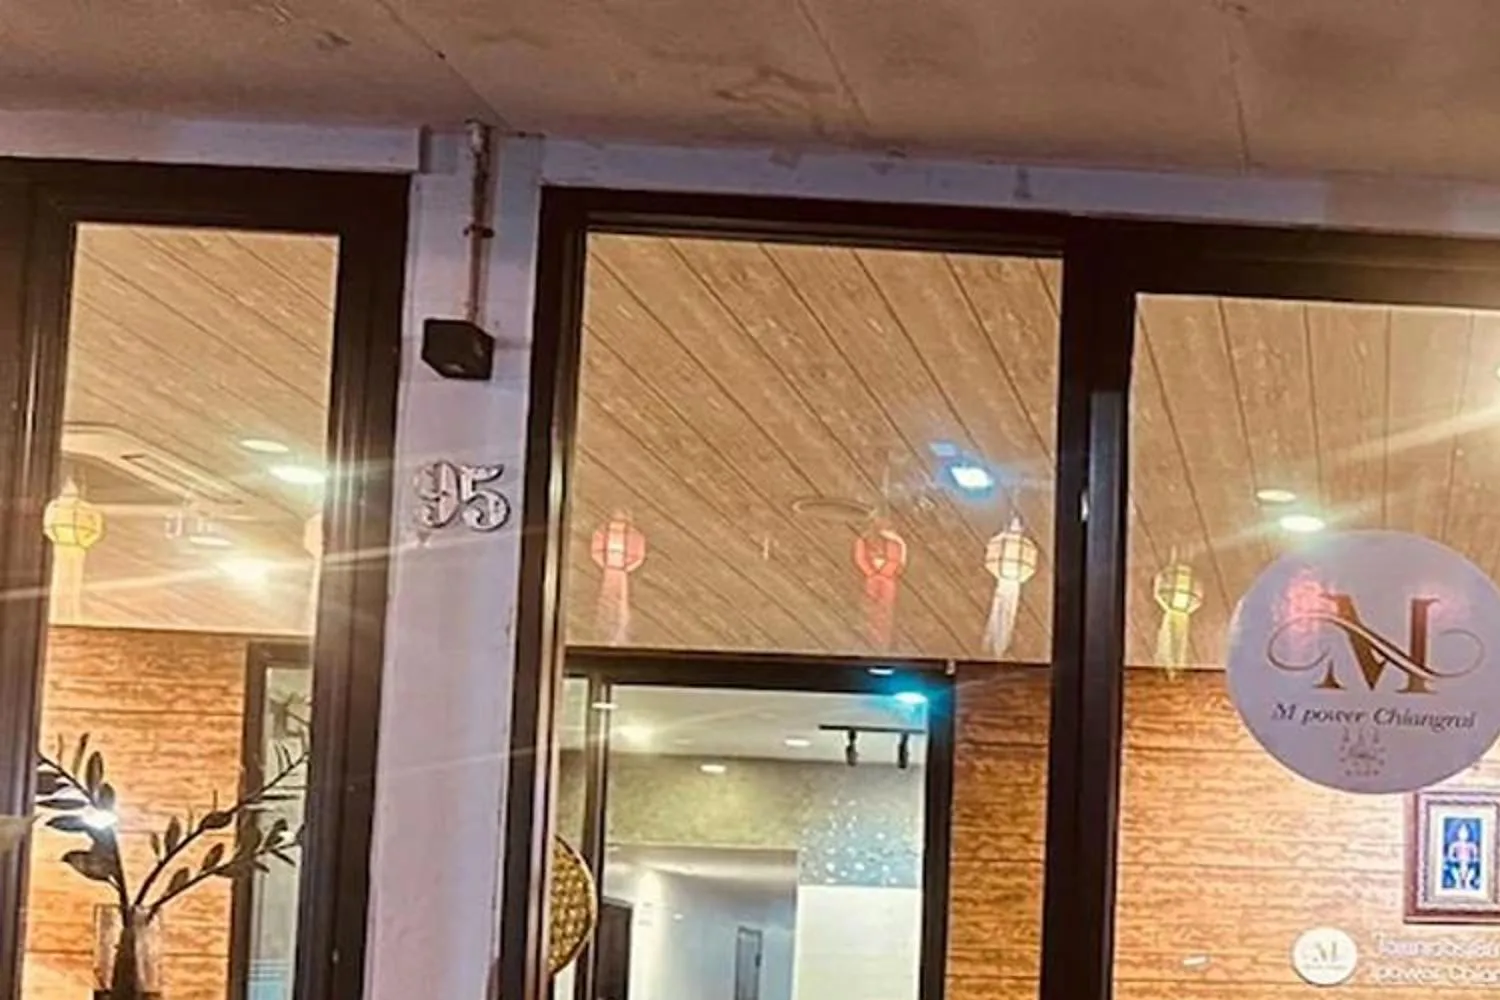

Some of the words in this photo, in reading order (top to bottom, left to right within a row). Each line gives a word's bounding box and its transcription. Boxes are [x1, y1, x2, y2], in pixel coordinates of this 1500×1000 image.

[413, 459, 511, 533] 95
[1271, 703, 1297, 721] M
[1301, 708, 1369, 726] power
[1373, 706, 1477, 733] Chiangrai
